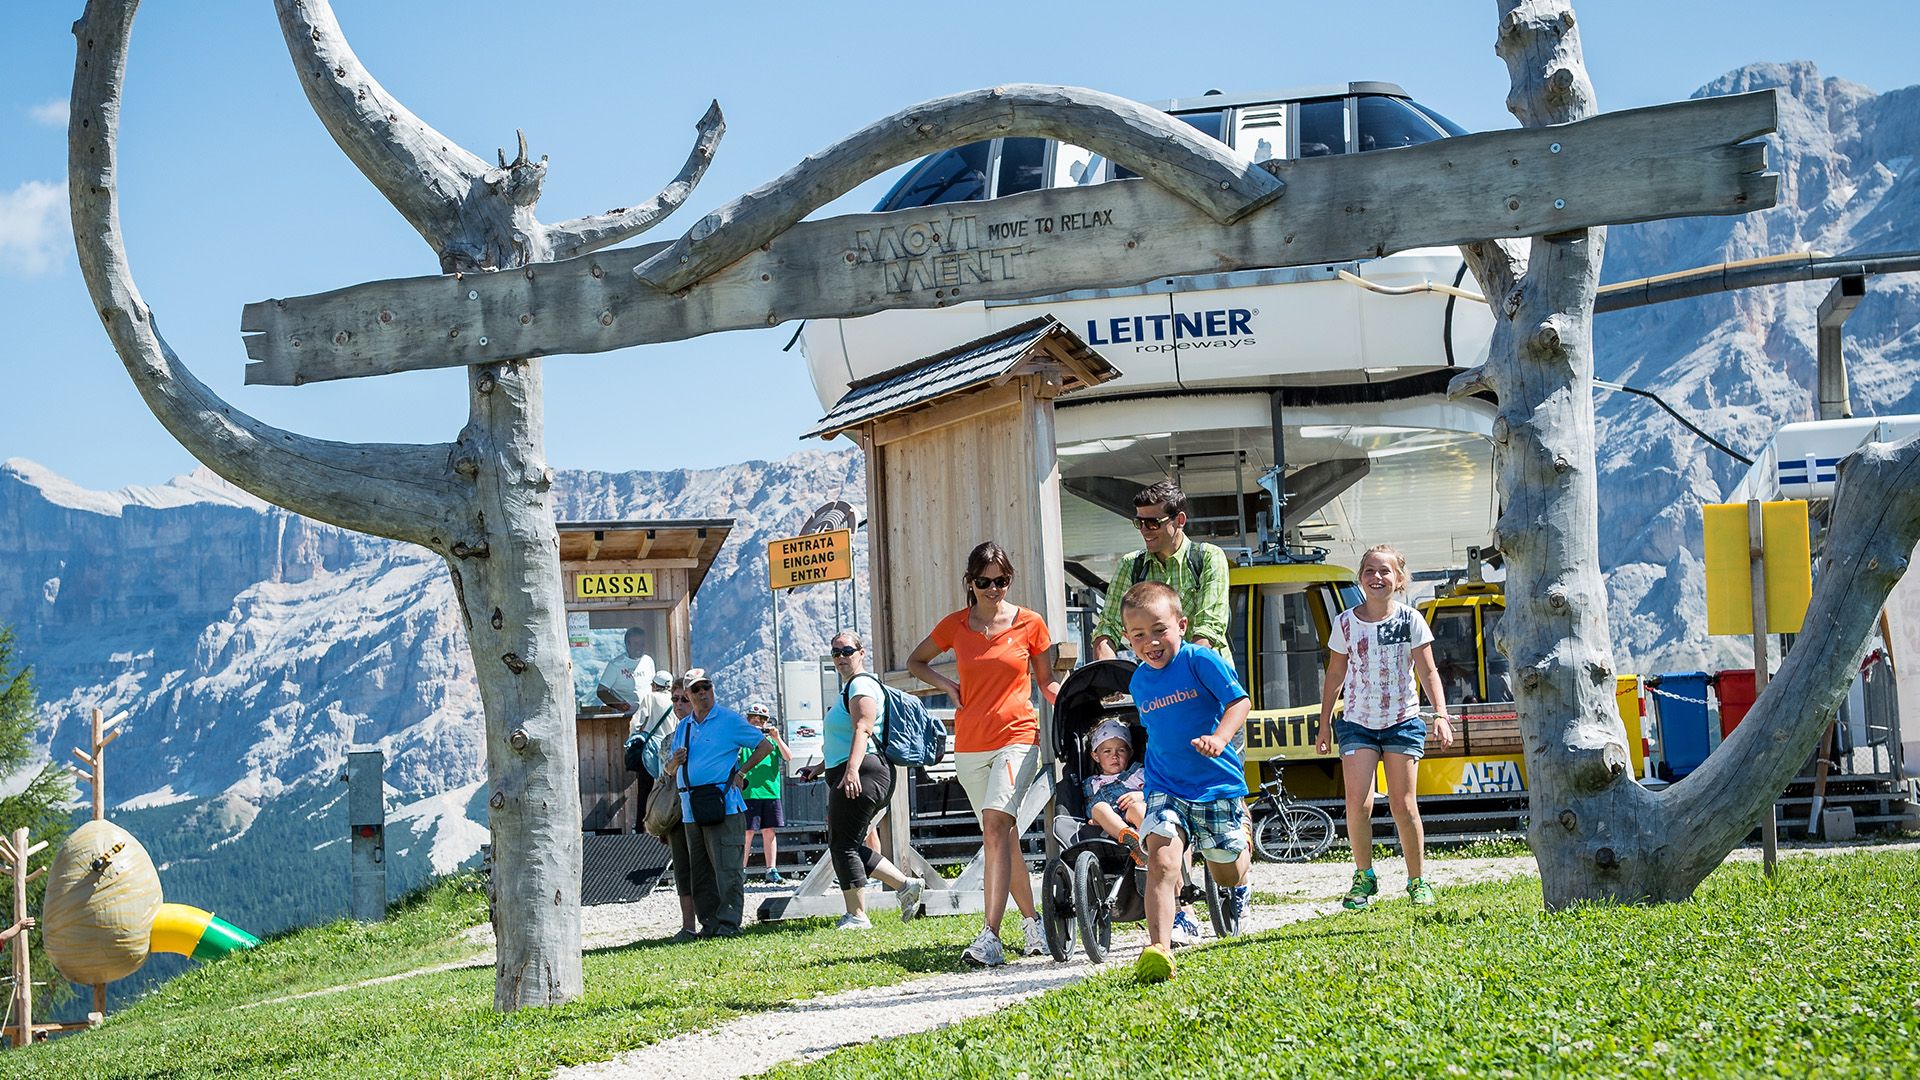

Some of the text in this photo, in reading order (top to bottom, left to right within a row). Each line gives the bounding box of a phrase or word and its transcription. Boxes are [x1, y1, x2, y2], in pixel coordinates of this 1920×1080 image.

[988, 209, 1113, 241] MOVE TO RELAX
[856, 215, 980, 264] MOVI
[884, 245, 1022, 294] MENT
[1135, 336, 1257, 354] ropeways
[782, 537, 834, 554] ENTRATA
[783, 551, 835, 569] EINGANG
[583, 576, 648, 594] CASSA
[791, 566, 828, 582] ENTRY
[1140, 687, 1198, 714] Columbia
[1461, 761, 1522, 793] ALTA
